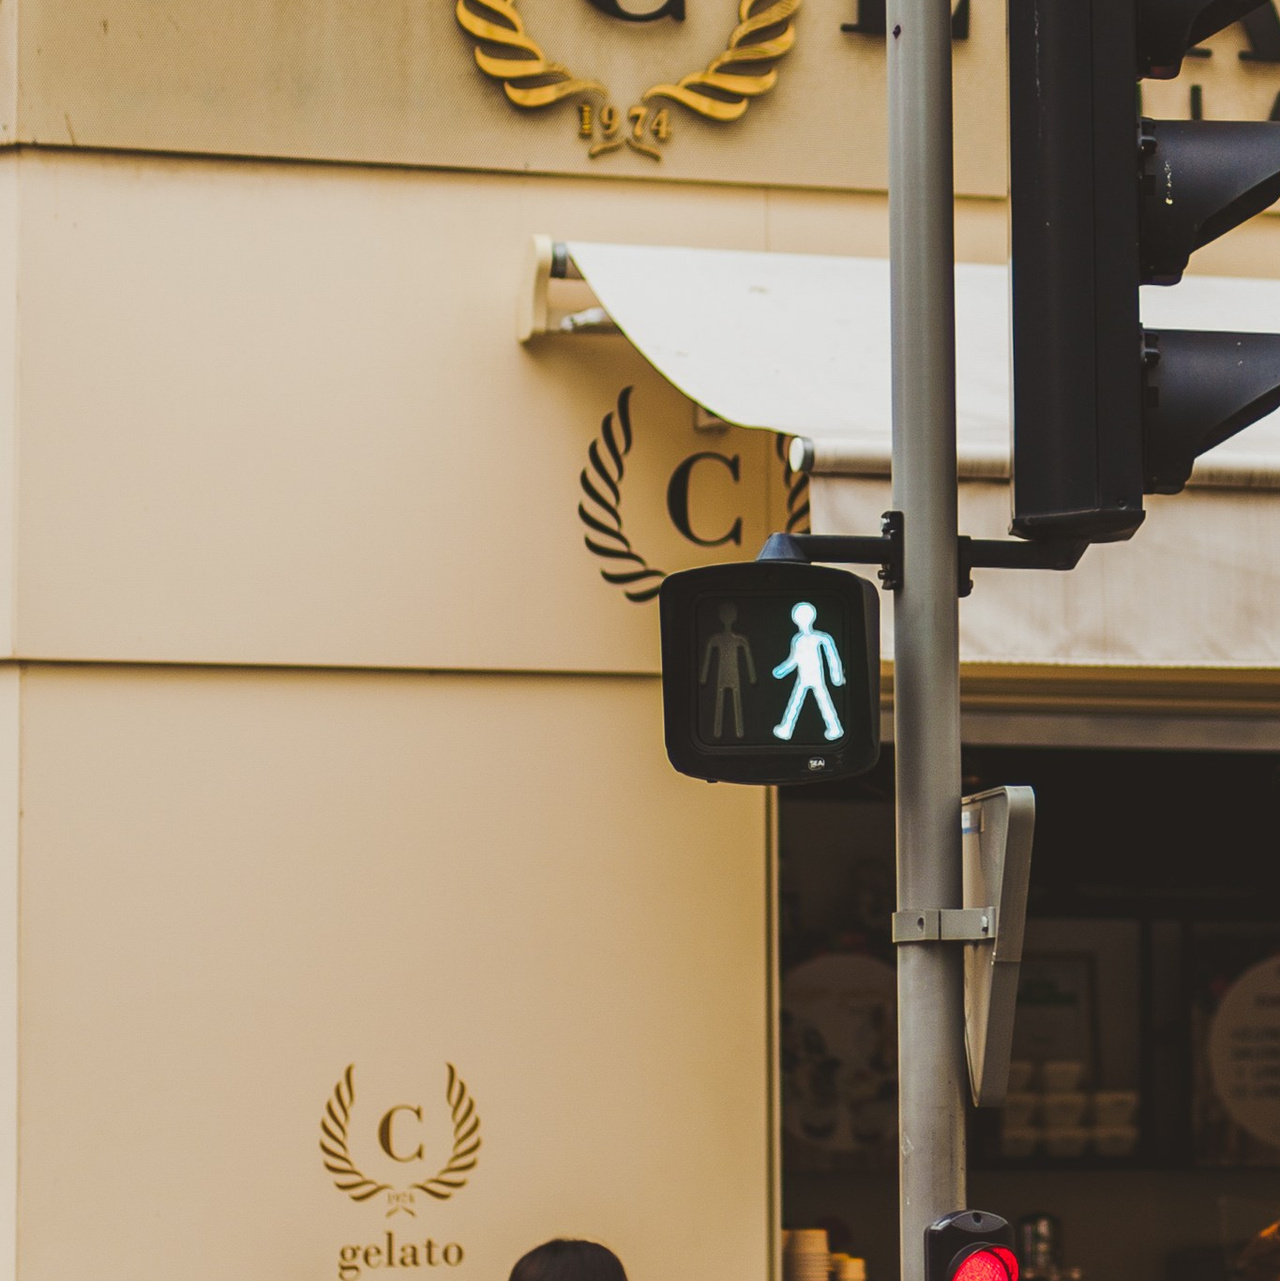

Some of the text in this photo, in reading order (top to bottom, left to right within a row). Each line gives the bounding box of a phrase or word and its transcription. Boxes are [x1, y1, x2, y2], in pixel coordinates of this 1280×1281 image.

[580, 104, 671, 139] 1974
[666, 451, 742, 547] C
[378, 1104, 424, 1163] C
